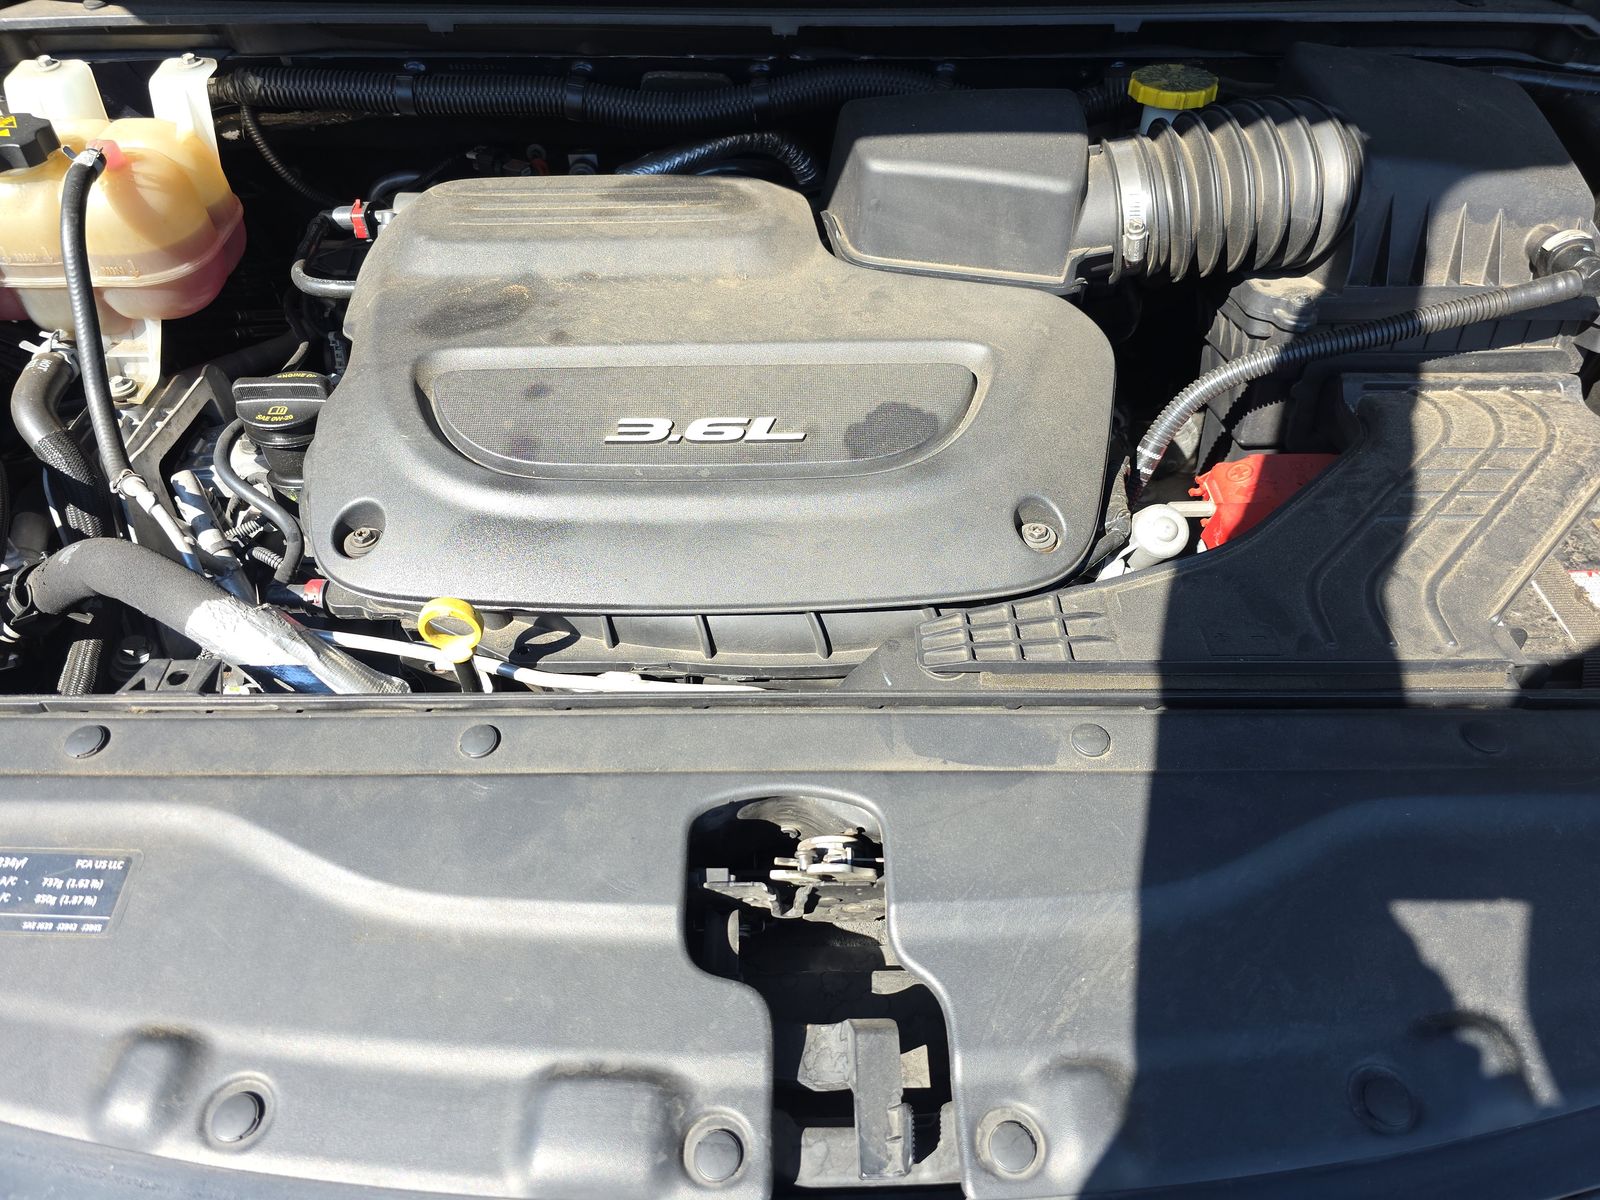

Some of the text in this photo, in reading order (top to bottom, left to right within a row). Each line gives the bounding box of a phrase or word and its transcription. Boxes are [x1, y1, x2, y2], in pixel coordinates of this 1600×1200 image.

[256, 414, 271, 422] SAE
[604, 417, 807, 444] 3.6L
[76, 859, 124, 870] FCA US LLC
